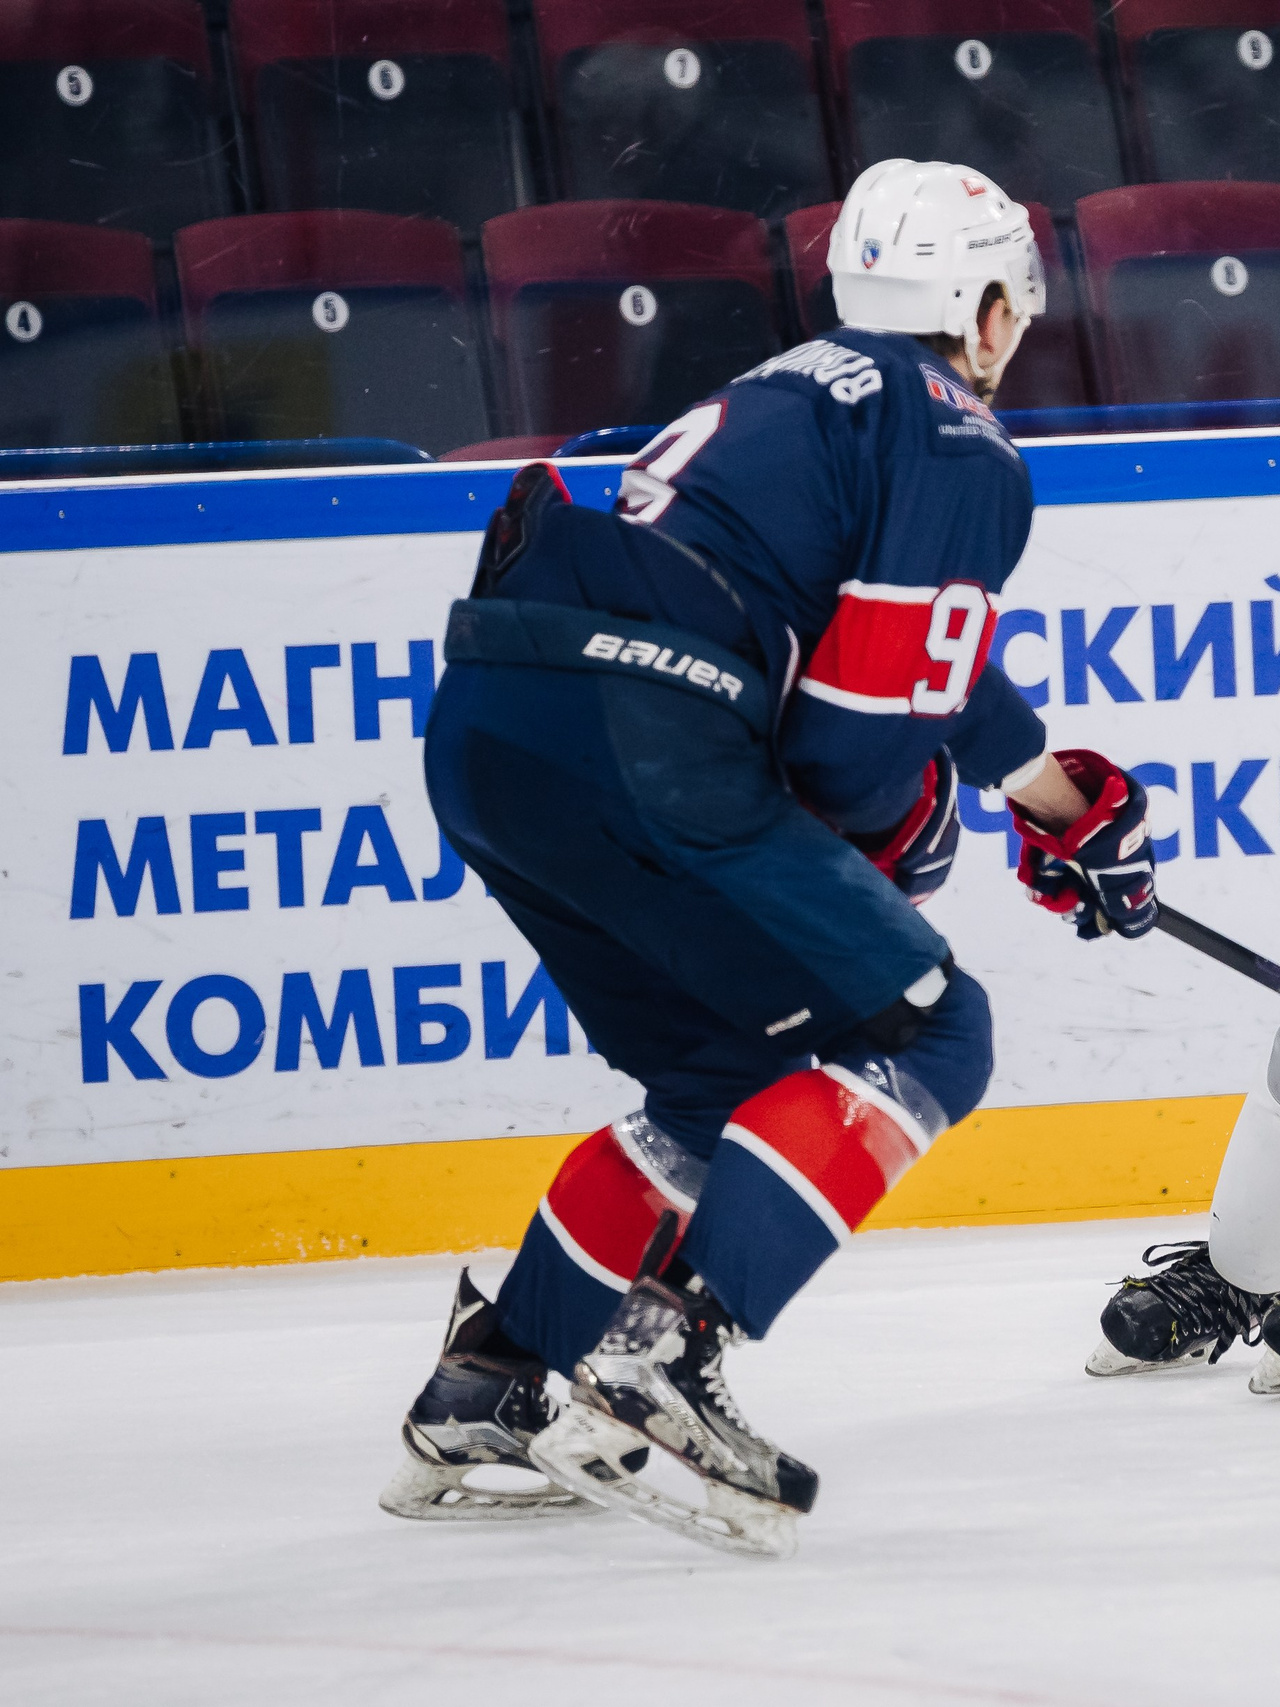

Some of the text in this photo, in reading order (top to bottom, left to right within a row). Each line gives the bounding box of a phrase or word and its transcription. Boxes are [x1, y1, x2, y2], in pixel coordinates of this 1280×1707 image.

[581, 632, 744, 702] BAUER
[909, 581, 989, 717] 9
[78, 961, 598, 1083] КОМБИ
